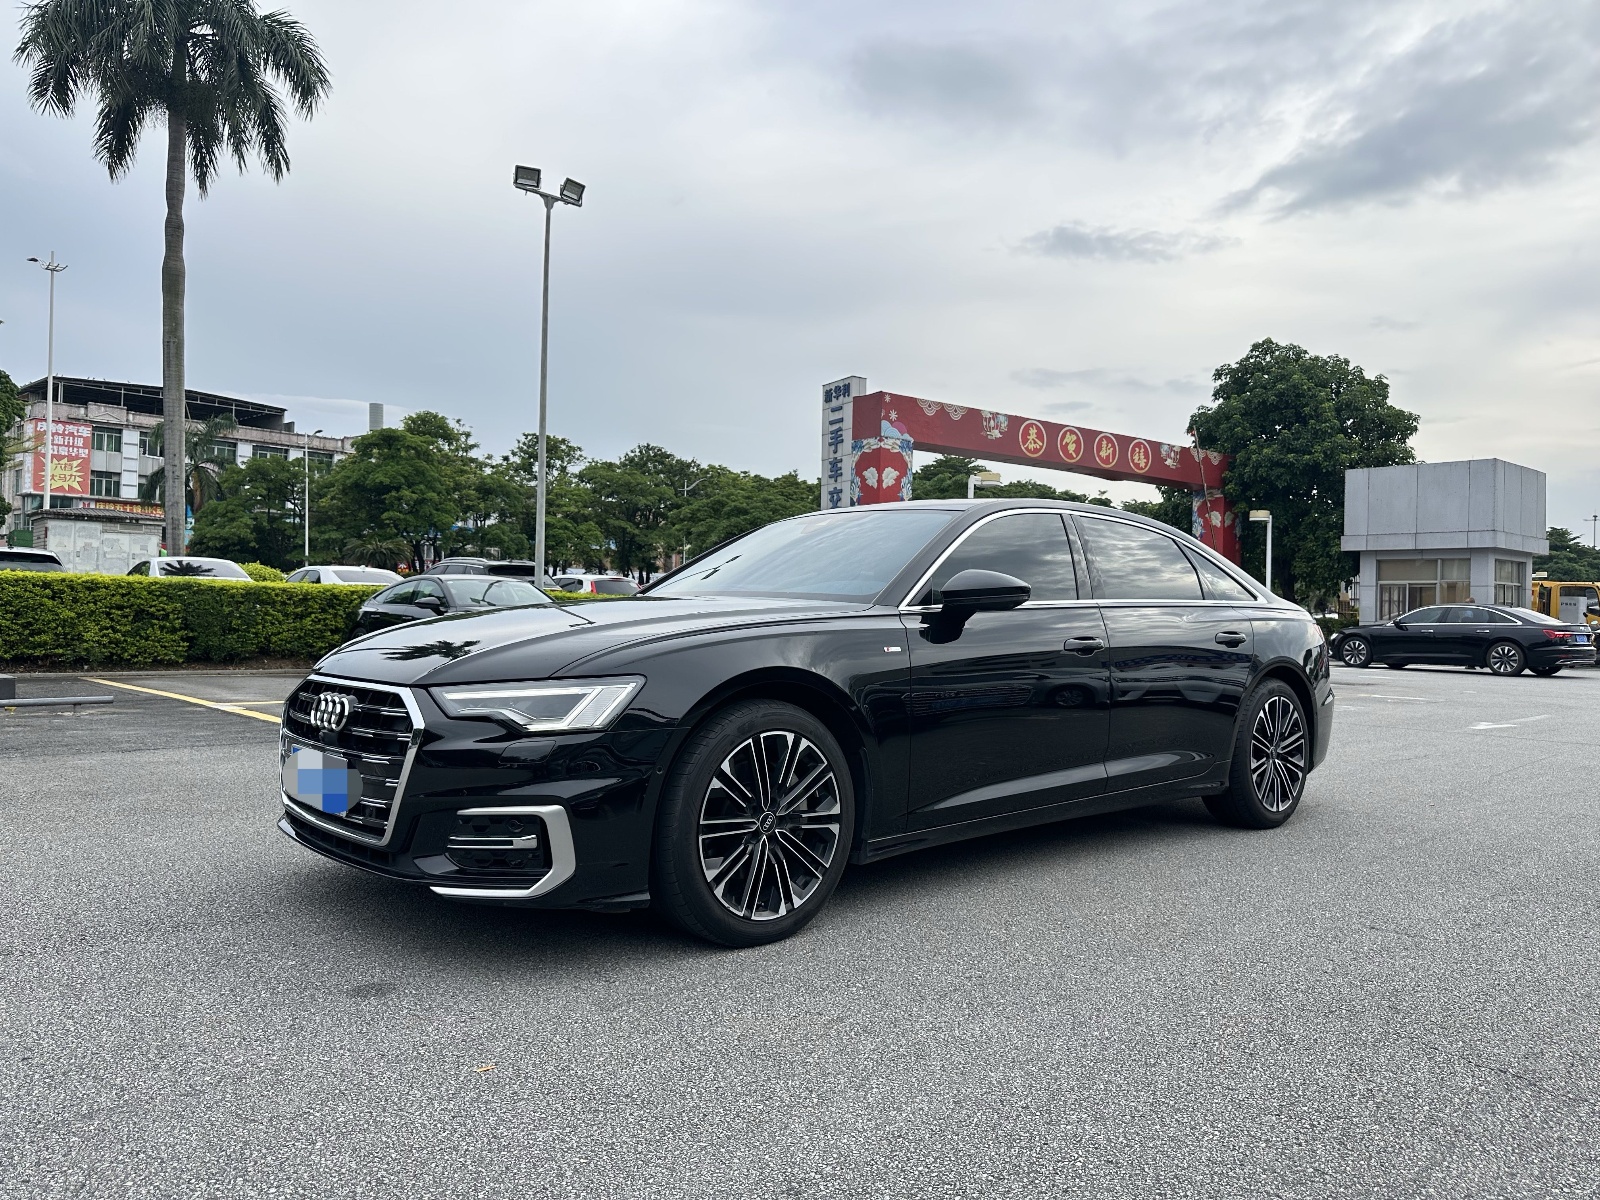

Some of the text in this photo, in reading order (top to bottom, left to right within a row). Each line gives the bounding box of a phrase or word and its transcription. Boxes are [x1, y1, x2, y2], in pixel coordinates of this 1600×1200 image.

[824, 382, 851, 404] 新华利
[44, 434, 84, 447] 新升级
[1023, 424, 1147, 469] 恭贺新禧
[828, 405, 844, 509] 二手车交
[53, 462, 74, 472] 六档
[49, 473, 77, 483] 大马力
